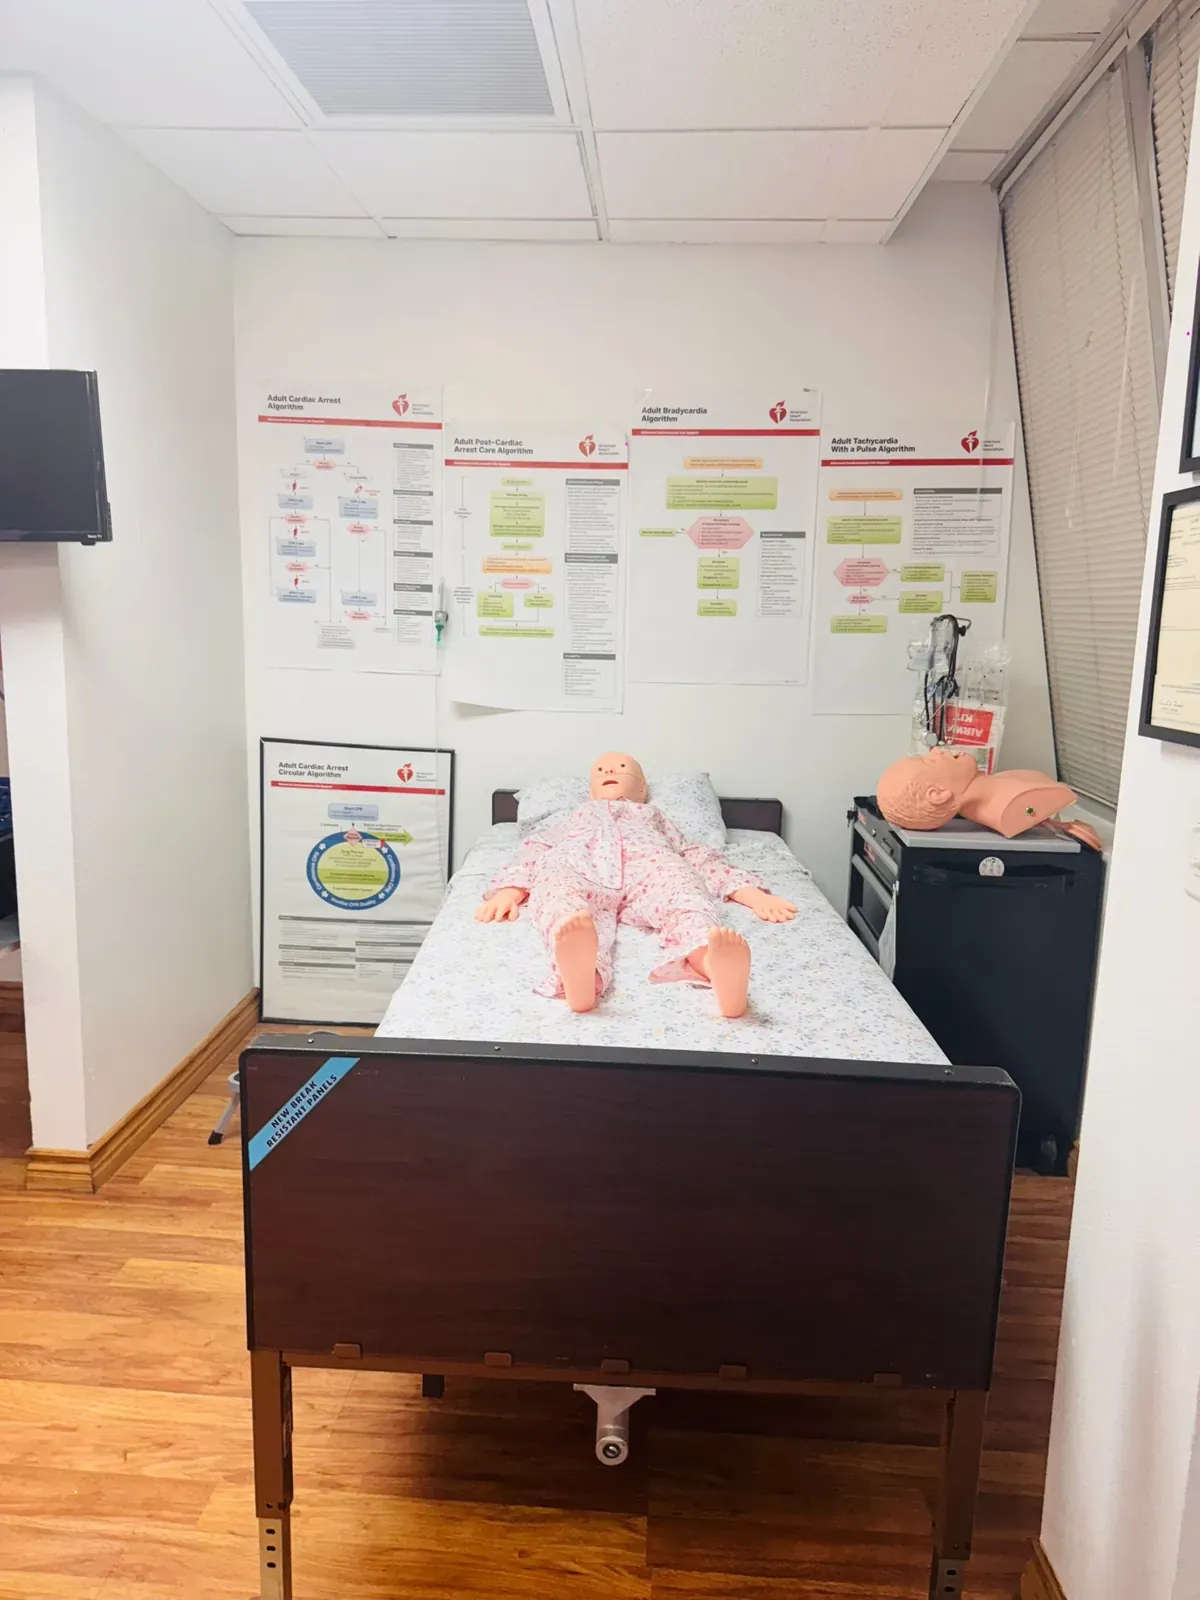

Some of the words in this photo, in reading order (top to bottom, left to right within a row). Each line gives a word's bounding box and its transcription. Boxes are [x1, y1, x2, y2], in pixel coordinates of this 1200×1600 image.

[268, 402, 304, 411] Algorithm
[663, 407, 708, 416] Bradycardia
[642, 415, 678, 424] Algorithm
[854, 438, 898, 446] Tachycardia
[497, 447, 534, 456] Algorithm
[878, 445, 916, 454] Algorithm
[307, 770, 342, 778] Algorithm
[271, 1108, 290, 1128] NEW
[290, 1080, 317, 1109] BREAK
[266, 1106, 307, 1148] RESISTANT
[306, 1074, 337, 1106] PANELS
